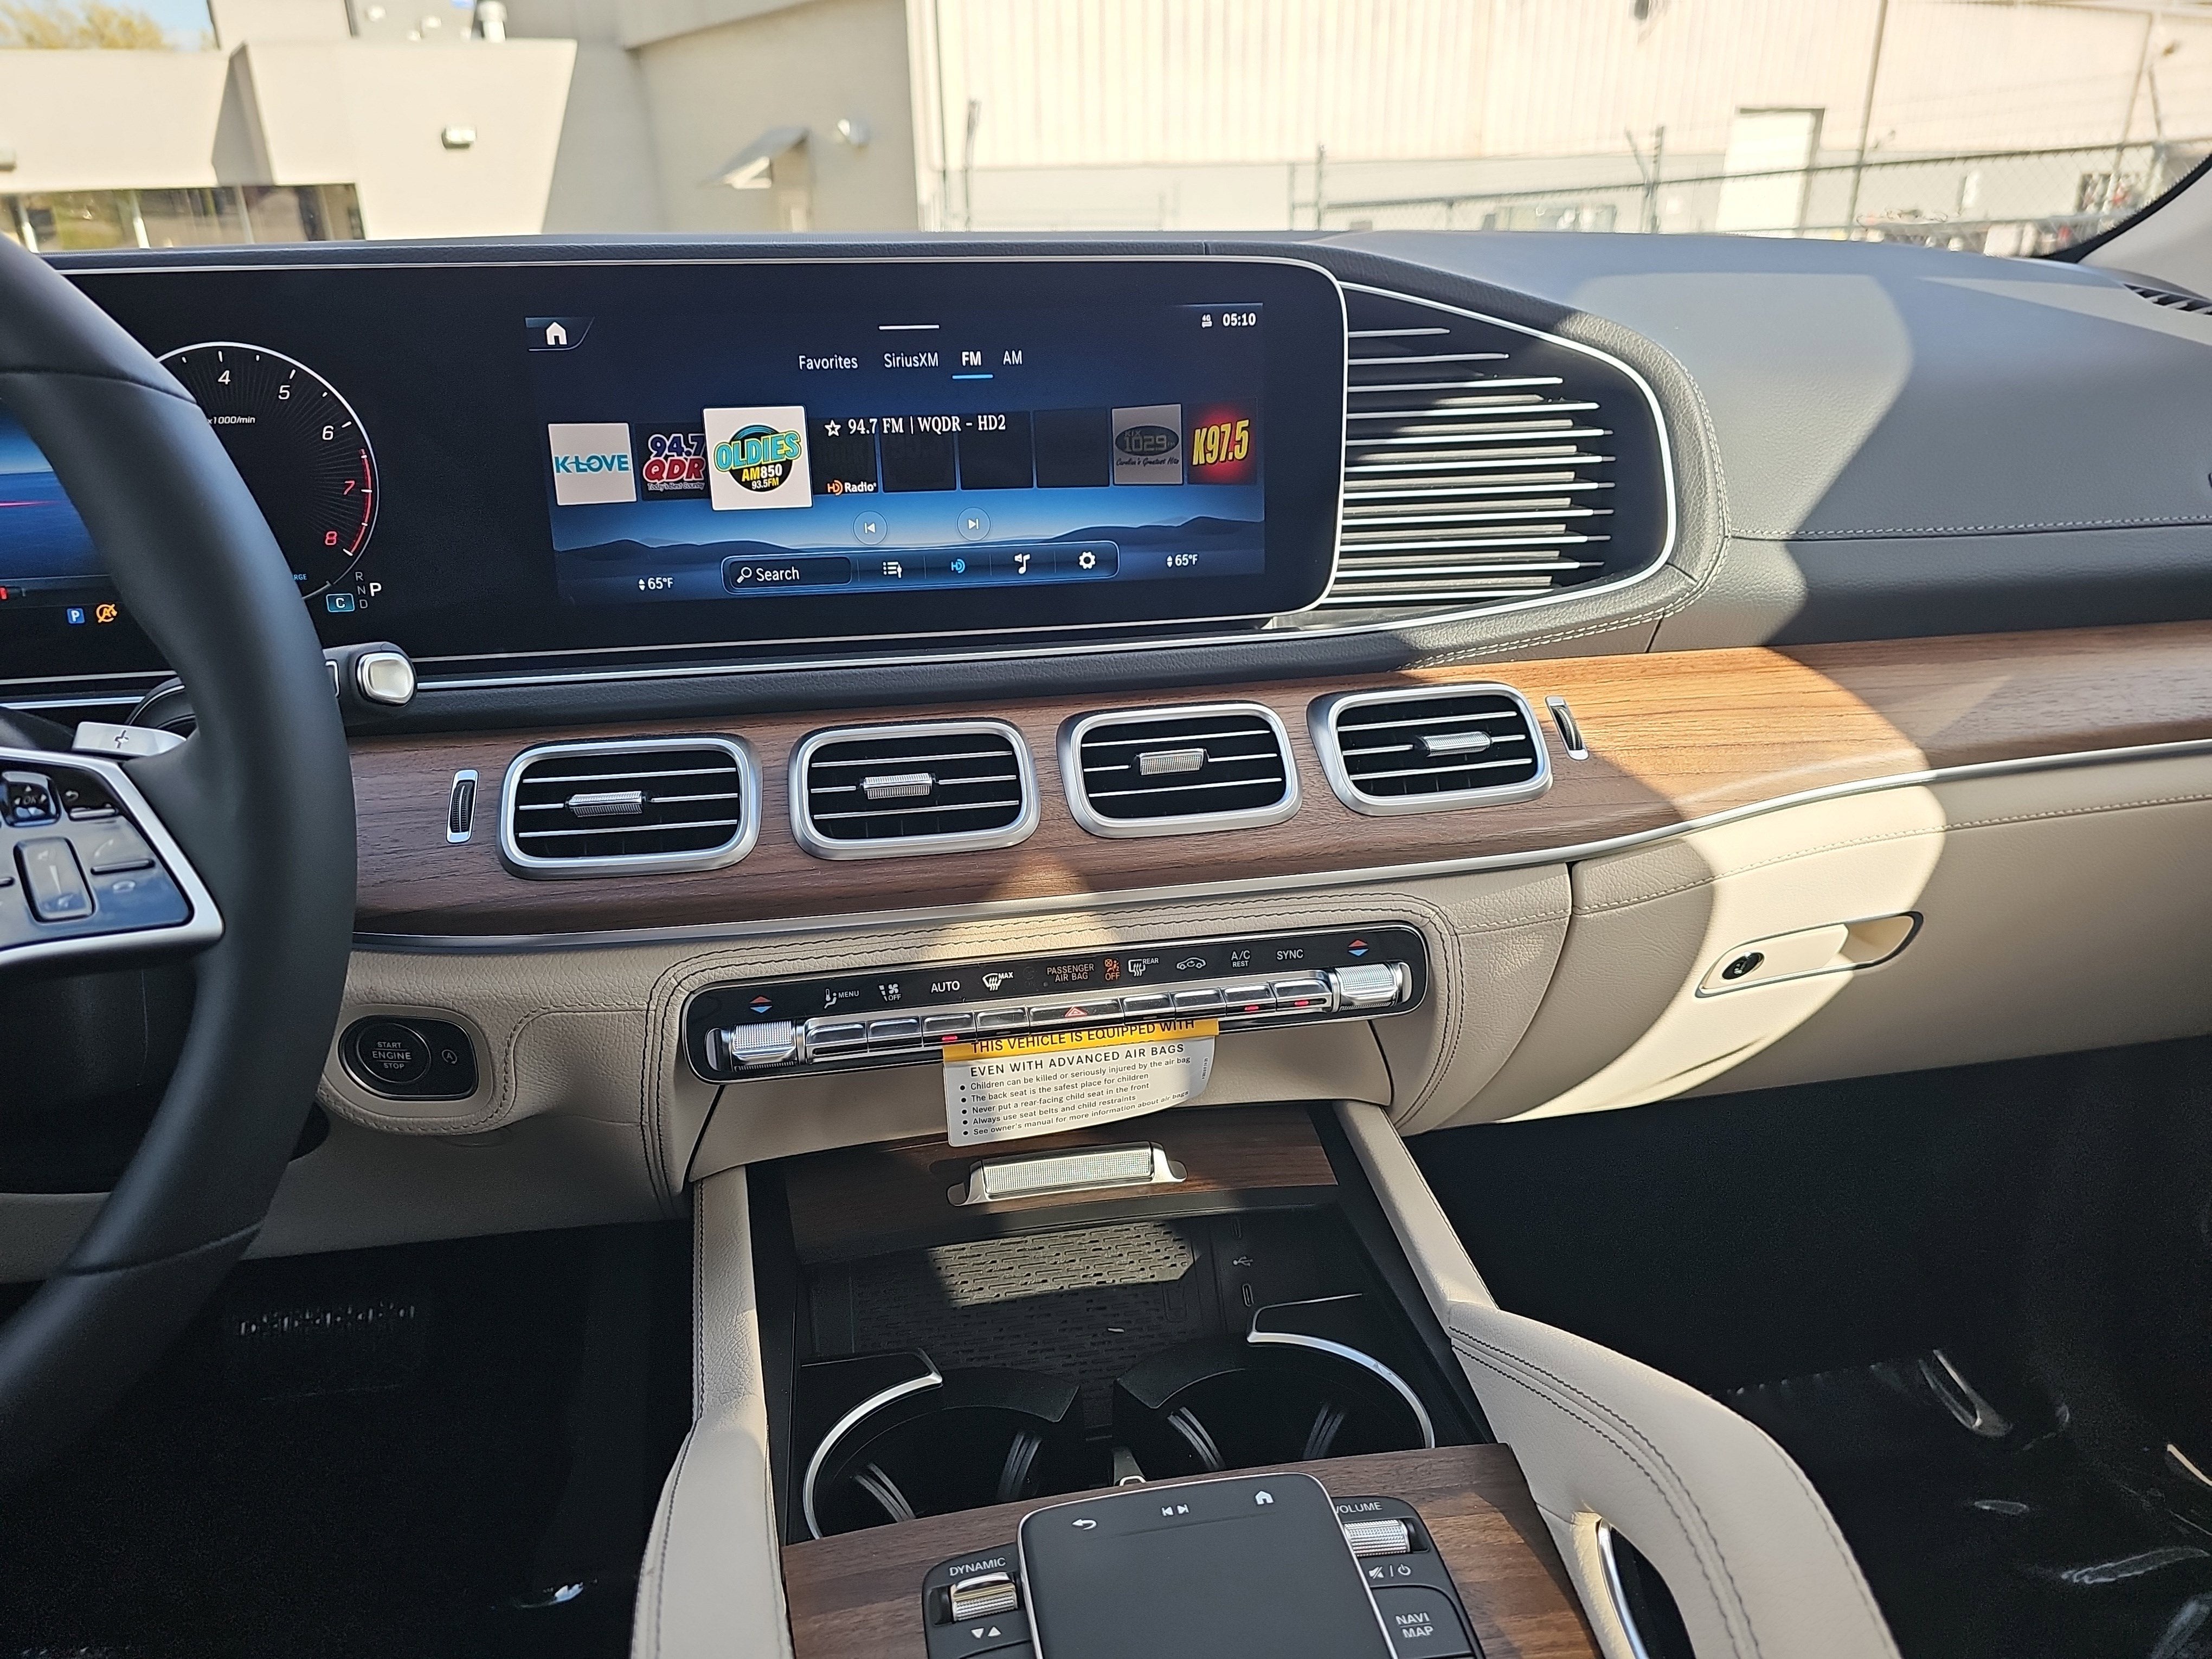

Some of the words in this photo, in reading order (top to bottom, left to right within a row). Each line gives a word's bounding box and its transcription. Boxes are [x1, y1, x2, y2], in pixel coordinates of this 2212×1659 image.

[1223, 313, 1256, 326] 05:10
[799, 353, 858, 370] Favorites
[884, 352, 939, 368] SiriusXM
[962, 351, 982, 366] FM
[1002, 350, 1023, 365] AM
[217, 370, 232, 385] 4
[278, 385, 291, 400] 5
[848, 418, 878, 434] 94.7
[882, 417, 904, 434] FM
[917, 415, 961, 435] WQDR
[978, 414, 1006, 430] HD2
[322, 425, 334, 440] 6
[648, 434, 705, 458] 94.7
[1192, 420, 1249, 465] K97.5
[713, 430, 801, 472] OLDIES
[643, 456, 705, 483] QDR
[742, 464, 782, 482] AM850
[343, 480, 355, 495] 7
[325, 531, 337, 545] 8
[1175, 554, 1198, 566] 65°F
[355, 571, 364, 581] R
[756, 566, 800, 582] Search
[357, 585, 366, 595] N
[370, 582, 382, 596] P
[647, 577, 673, 590] 65°F
[336, 597, 345, 608] C
[359, 599, 368, 609] D
[1231, 950, 1251, 961] A/C
[1277, 949, 1303, 960] SYNC
[998, 972, 1014, 980] MAX
[1047, 963, 1095, 975] PASSENGER
[1054, 974, 1069, 982] AIR
[1071, 972, 1088, 981] BAG
[1105, 973, 1121, 981] OFF
[931, 981, 960, 993] AUTO
[971, 1039, 1003, 1053] THIS
[1007, 1032, 1066, 1050] VEHICLE
[1070, 1031, 1083, 1043] IS
[1088, 1023, 1155, 1040] EQUIPPED
[1159, 1020, 1194, 1032] WITH
[372, 1051, 412, 1060] ENGINE
[971, 1064, 1004, 1077] EVEN
[1009, 1059, 1043, 1072] WITH
[1049, 1051, 1120, 1068] ADVANCED
[1125, 1049, 1146, 1059] AIR
[1151, 1044, 1184, 1056] BAGS
[971, 1080, 1004, 1090] Children
[1036, 1073, 1057, 1082] killed
[1071, 1068, 1106, 1078] seriously
[1109, 1062, 1136, 1073] injured
[1139, 1062, 1147, 1071] by
[1177, 1056, 1191, 1065] bag
[971, 1095, 986, 1103] The
[988, 1091, 1007, 1101] back
[1010, 1089, 1027, 1097] seat
[1054, 1082, 1078, 1092] safest
[1081, 1079, 1102, 1089] place
[1104, 1076, 1115, 1085] for
[1117, 1073, 1149, 1083] children
[972, 1105, 996, 1115] Never
[998, 1103, 1011, 1112] put
[1021, 1096, 1064, 1107] rear-facing
[1066, 1091, 1085, 1101] child
[1087, 1090, 1104, 1098] seat
[1131, 1082, 1149, 1091] front
[973, 1115, 1001, 1126] Always
[1019, 1109, 1036, 1118] seat
[1039, 1107, 1058, 1116] belts
[1061, 1104, 1075, 1113] and
[1078, 1100, 1096, 1110] child
[1098, 1095, 1136, 1107] restraints
[973, 1128, 988, 1136] See
[991, 1122, 1022, 1133] owner's
[1025, 1118, 1053, 1128] manual
[1069, 1113, 1089, 1121] more
[1091, 1104, 1135, 1117] information
[1137, 1099, 1159, 1108] about
[1172, 1090, 1189, 1100] bags
[949, 1558, 1006, 1576] DYNAMIC
[1396, 1612, 1430, 1625] NAVI
[1402, 1626, 1433, 1638] MAP
